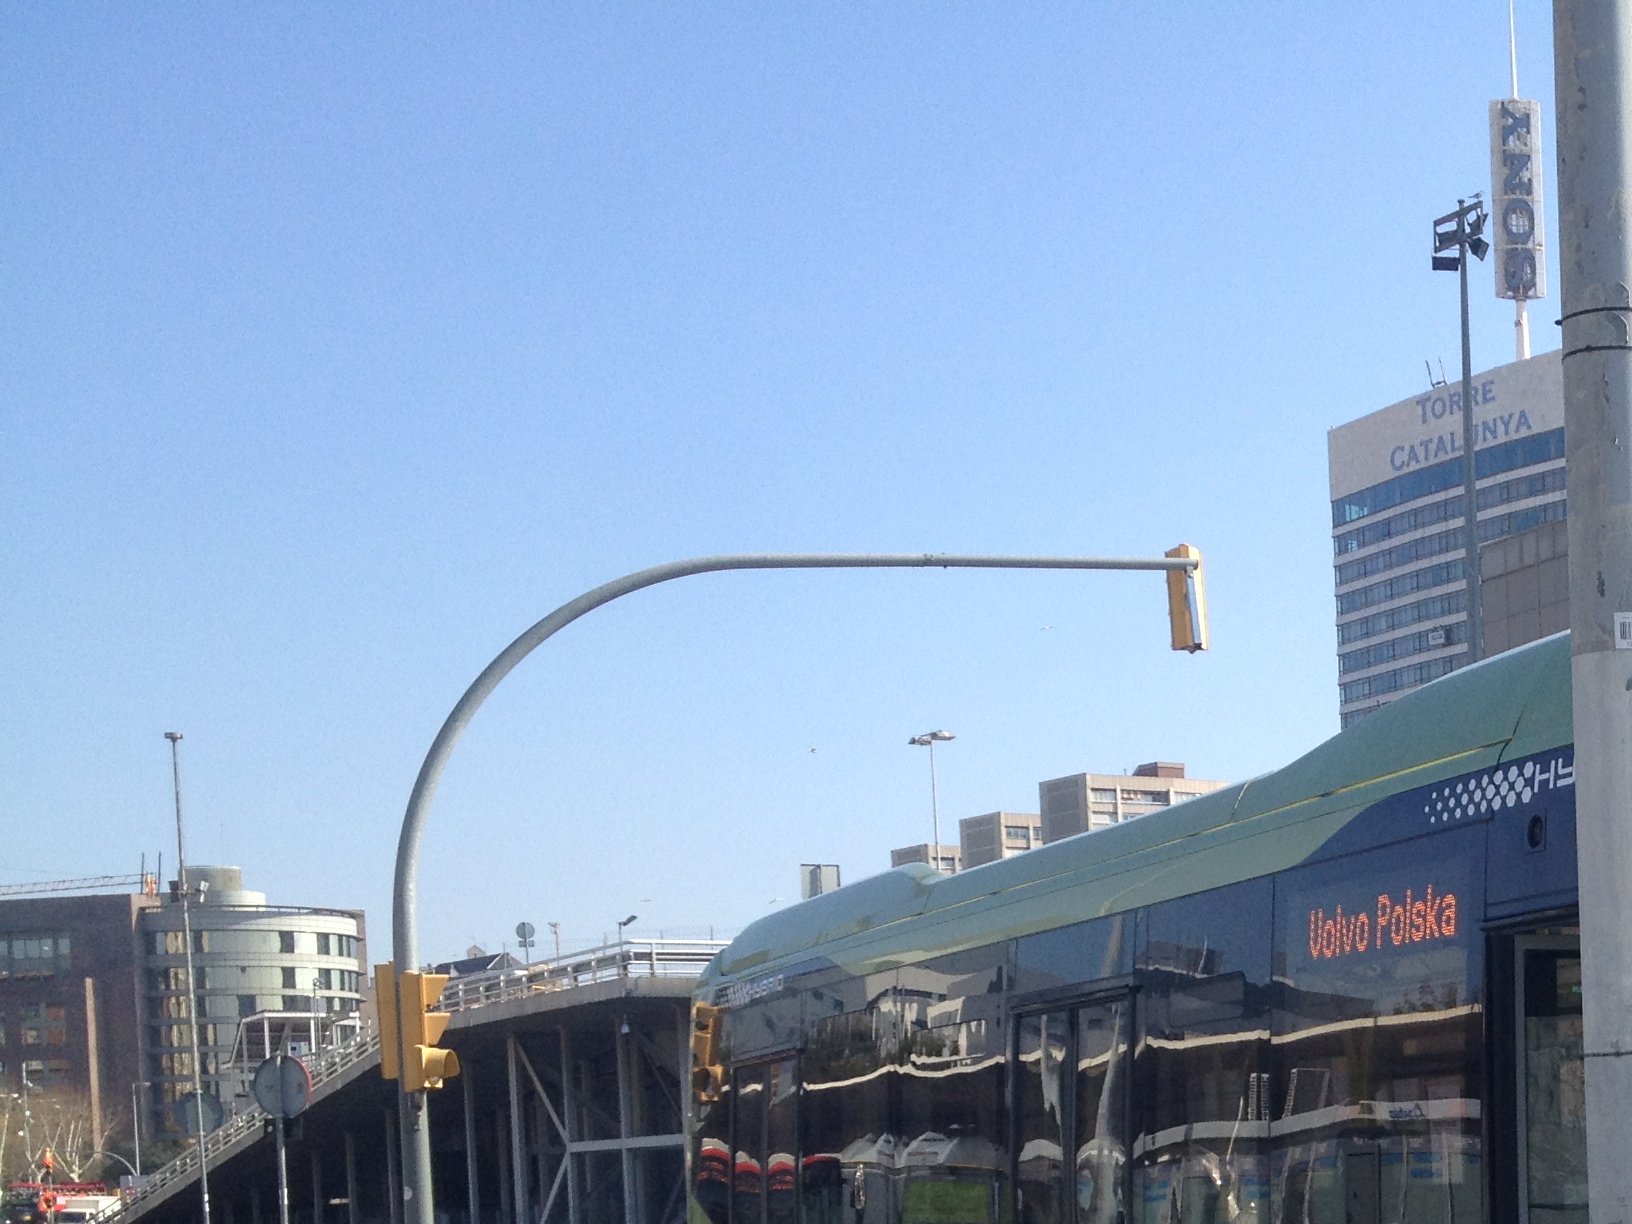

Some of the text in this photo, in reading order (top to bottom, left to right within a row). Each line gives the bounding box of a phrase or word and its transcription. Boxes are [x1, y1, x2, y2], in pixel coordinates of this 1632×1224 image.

[1502, 101, 1536, 292] SONY
[1309, 884, 1458, 960] Volvo Polska
